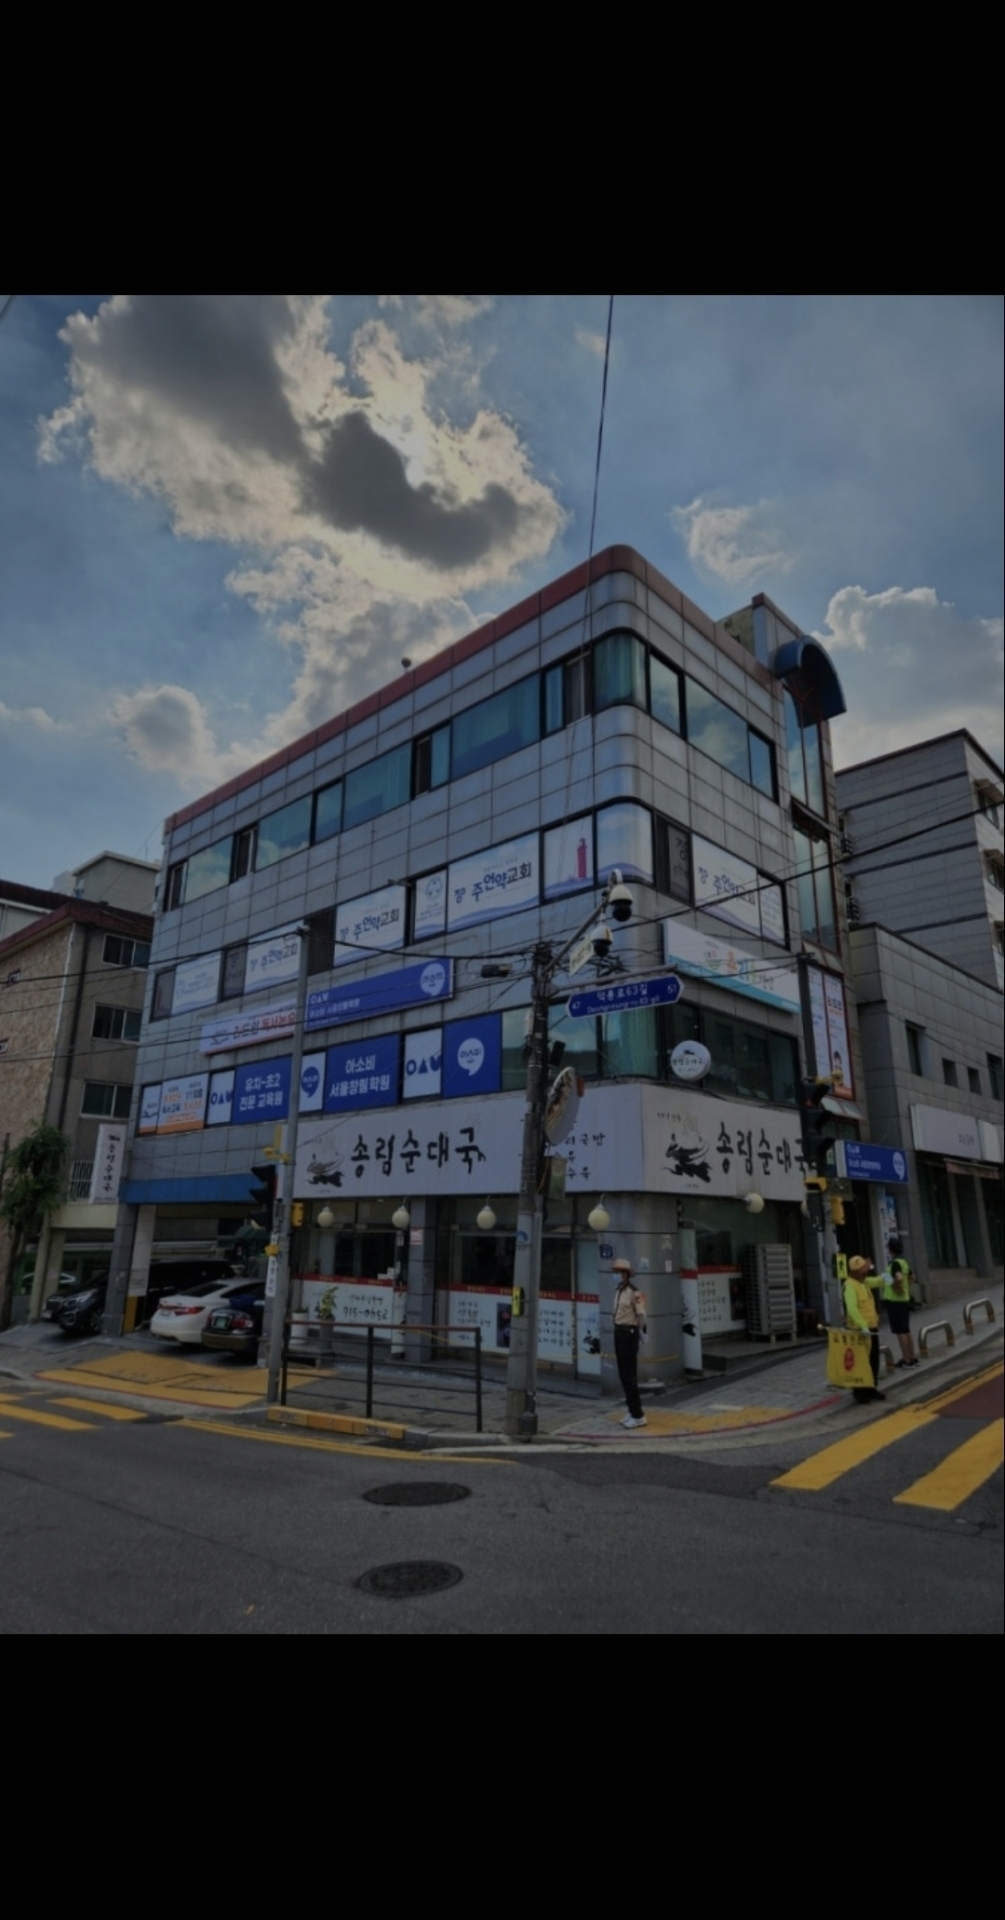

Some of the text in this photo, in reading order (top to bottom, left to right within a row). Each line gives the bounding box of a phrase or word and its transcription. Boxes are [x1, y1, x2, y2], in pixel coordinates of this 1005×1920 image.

[472, 862, 532, 903] 주언약교회
[353, 907, 400, 941] 주언약교회
[344, 1054, 376, 1075] 아소비
[257, 1091, 284, 1108] 교육원
[351, 1127, 486, 1178] 송림순대국
